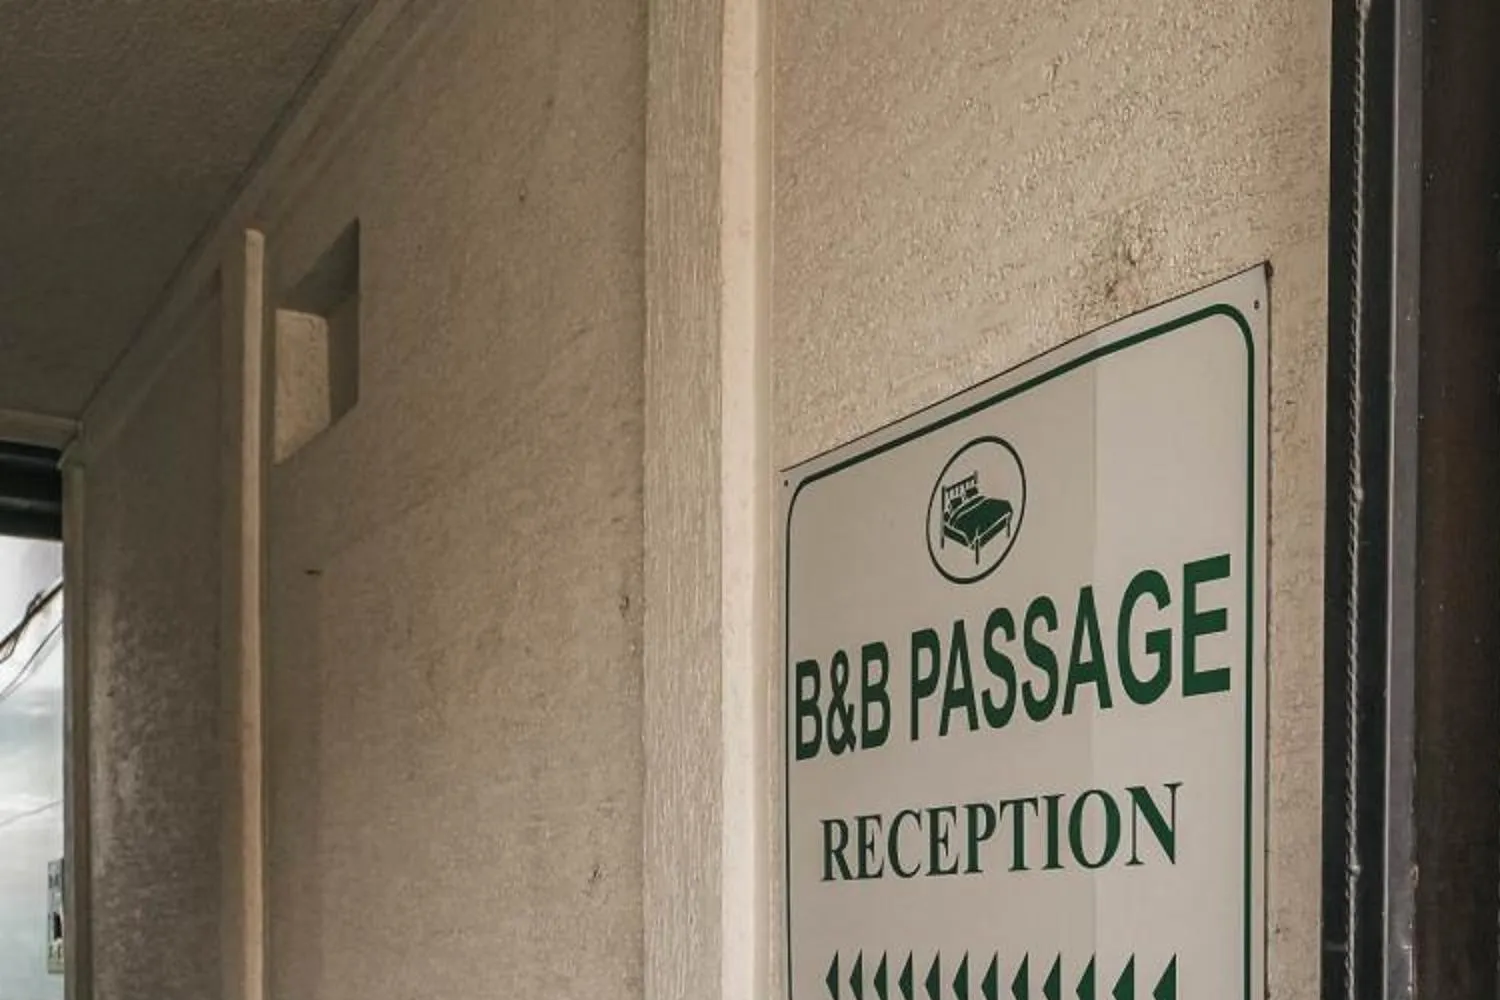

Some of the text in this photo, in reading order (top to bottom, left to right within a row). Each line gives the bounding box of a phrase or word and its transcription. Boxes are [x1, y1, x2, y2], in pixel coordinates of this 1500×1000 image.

[795, 553, 1232, 762] B&B PASSAGE
[820, 781, 1183, 883] RECEPTION
